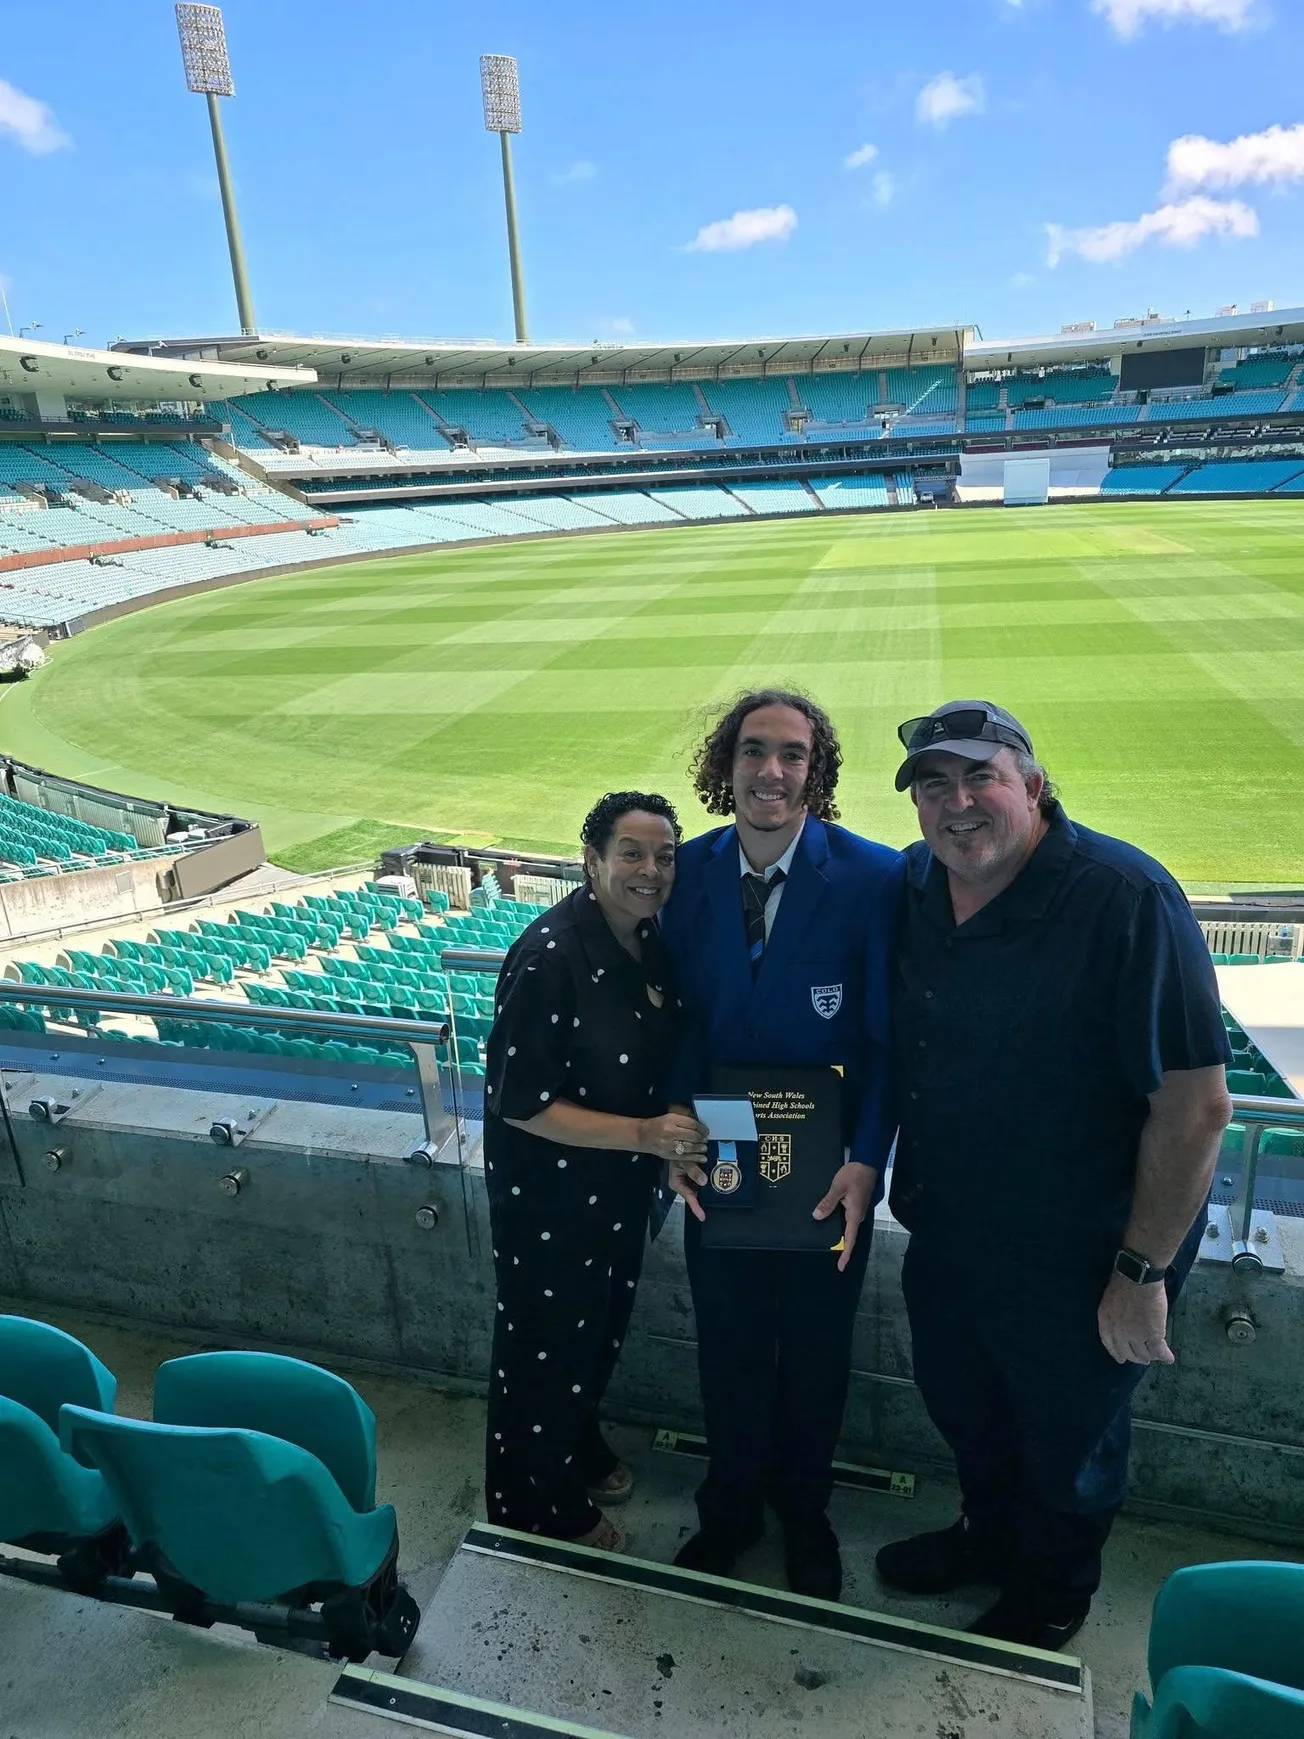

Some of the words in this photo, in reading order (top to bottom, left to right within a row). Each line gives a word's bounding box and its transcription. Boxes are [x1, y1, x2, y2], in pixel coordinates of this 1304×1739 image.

[816, 986, 838, 994] COLO
[748, 1091, 763, 1099] New
[763, 1091, 783, 1099] South
[771, 1101, 788, 1110] High
[789, 1101, 815, 1109] Schools
[899, 1475, 907, 1484] A
